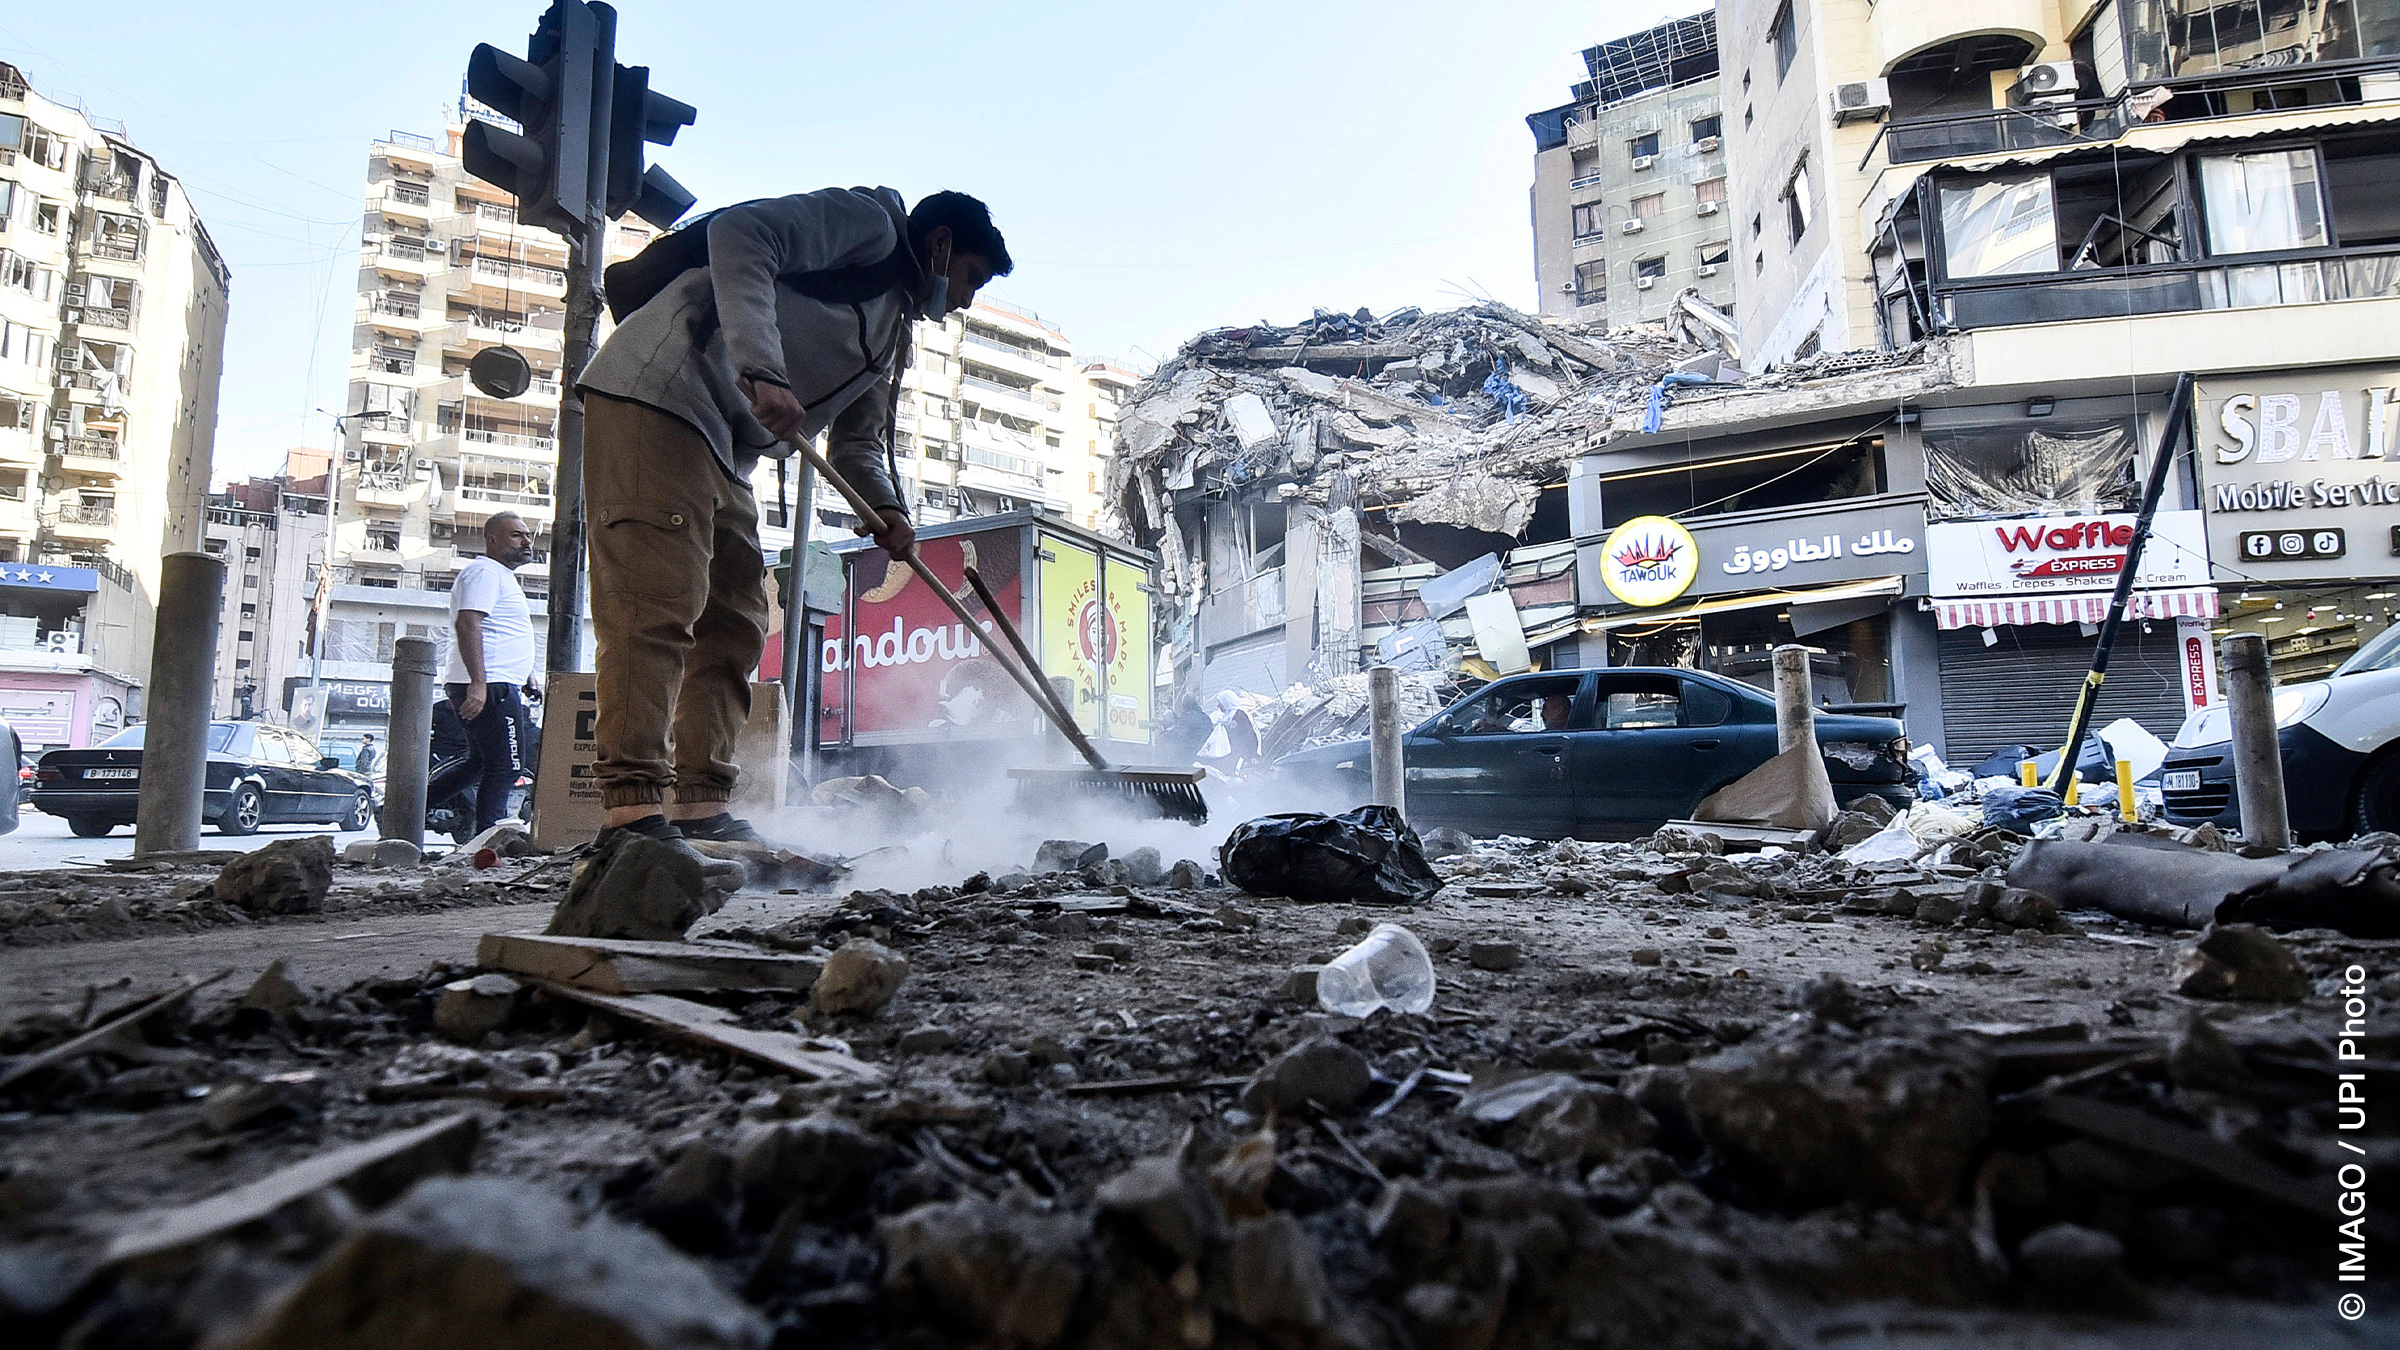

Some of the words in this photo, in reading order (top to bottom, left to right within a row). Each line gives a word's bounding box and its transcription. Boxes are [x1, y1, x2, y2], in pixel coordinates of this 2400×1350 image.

[1850, 529, 1915, 556] ملك
[1995, 521, 2134, 553] Waffle
[1722, 534, 1842, 575] الطاووق
[2050, 558, 2117, 572] EXPRESS
[1619, 564, 1677, 583] TAWOUK
[1956, 581, 2002, 591] Waffles
[2012, 578, 2056, 589] Crepes
[2066, 576, 2113, 586] Shakes
[2146, 573, 2187, 583] Cream
[1066, 580, 1095, 628] SMILES
[1117, 621, 1128, 672] MADE
[822, 615, 993, 673] andour
[2188, 644, 2205, 696] EXPRESS
[505, 716, 520, 771] ARMOUR
[90, 769, 97, 778] B
[101, 769, 133, 778] 173146
